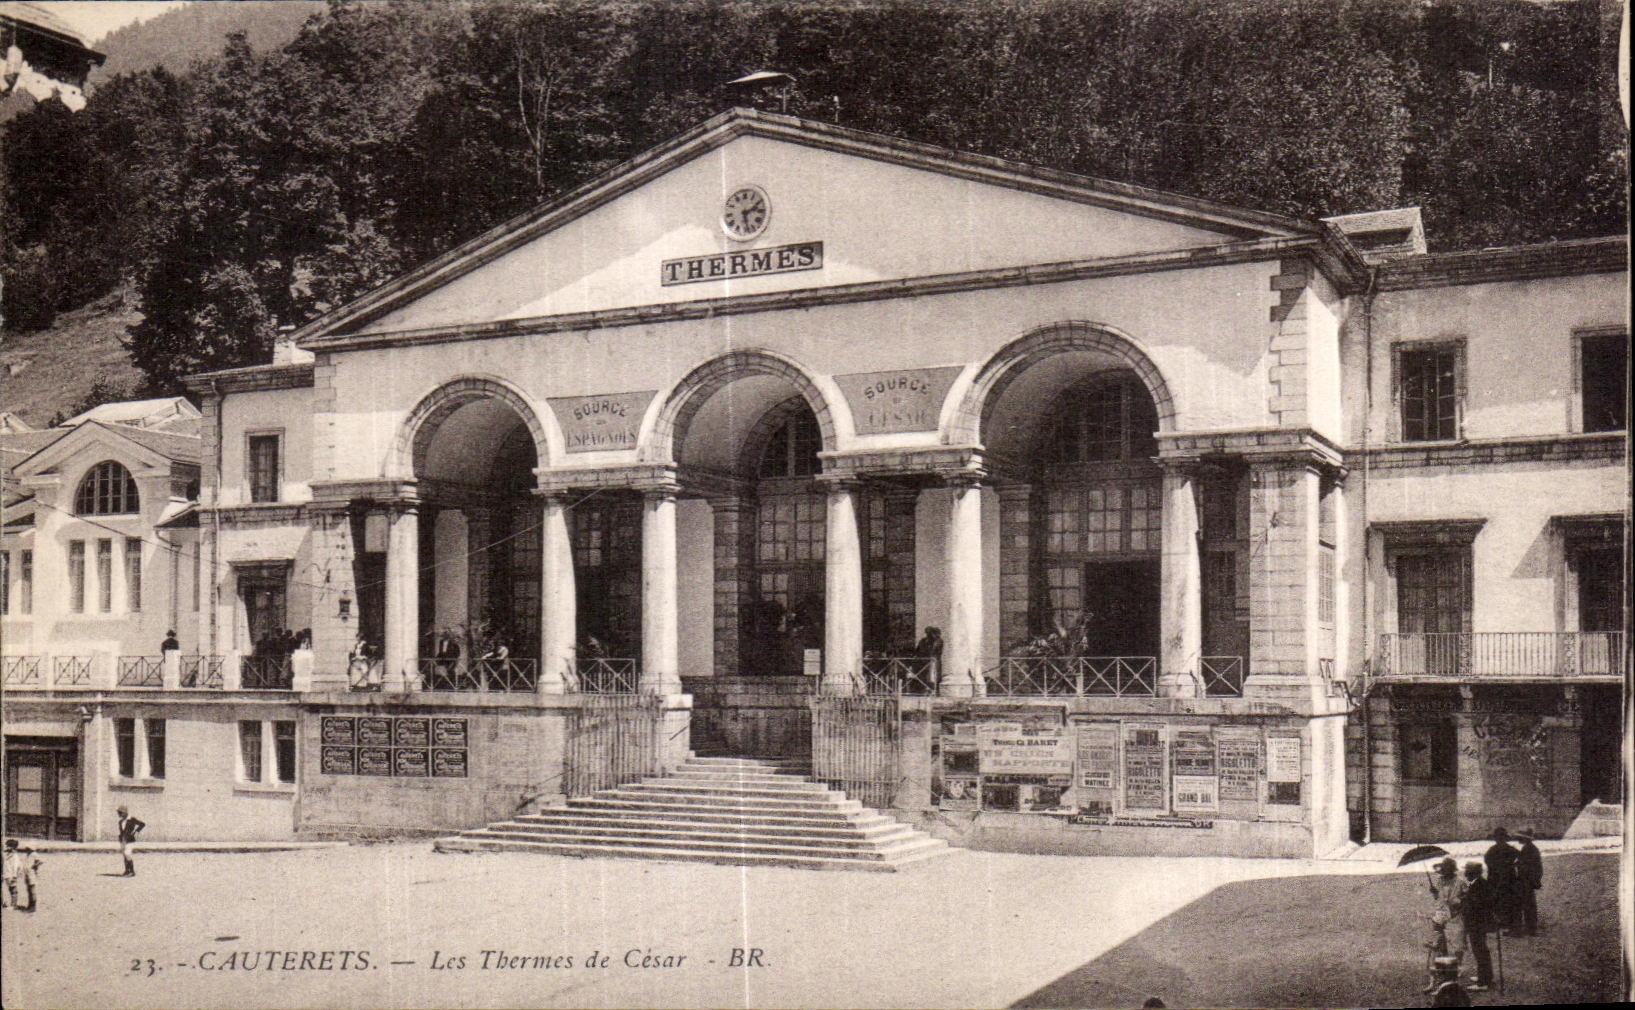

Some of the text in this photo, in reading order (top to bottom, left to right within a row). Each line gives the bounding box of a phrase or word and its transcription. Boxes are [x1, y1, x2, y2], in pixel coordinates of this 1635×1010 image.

[666, 246, 815, 281] THERMES
[864, 377, 931, 399] SOURCE
[573, 400, 628, 420] SOURCE
[1178, 792, 1212, 803] GRAND BAL
